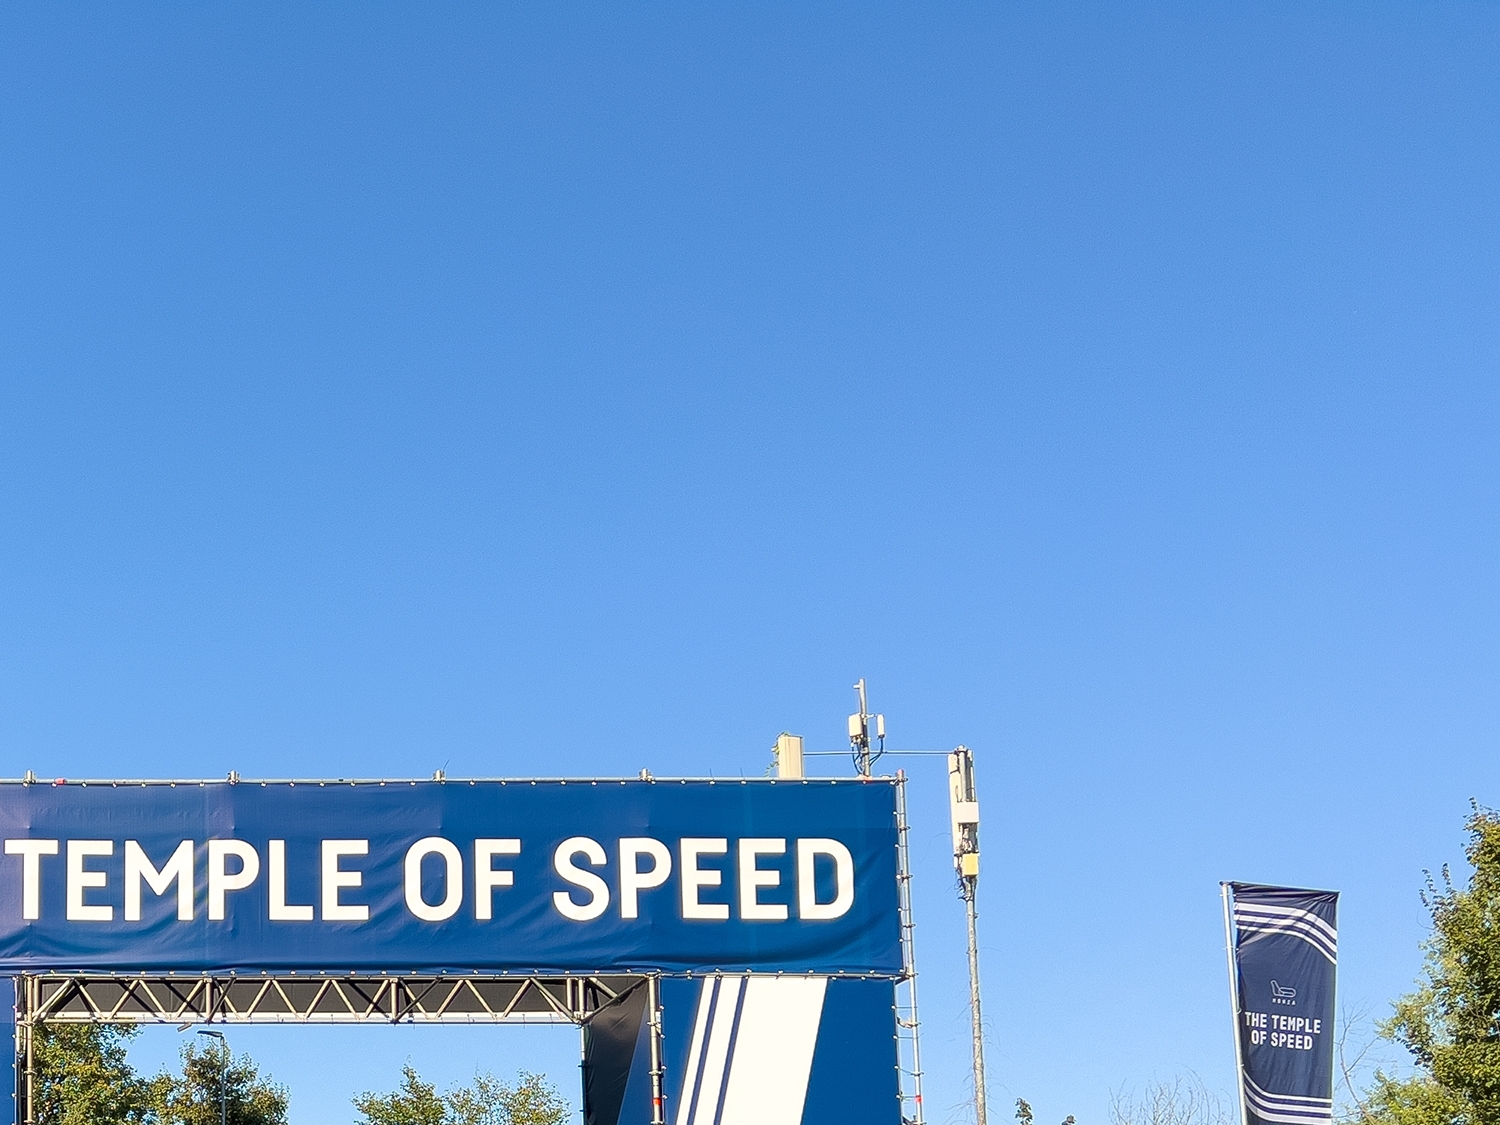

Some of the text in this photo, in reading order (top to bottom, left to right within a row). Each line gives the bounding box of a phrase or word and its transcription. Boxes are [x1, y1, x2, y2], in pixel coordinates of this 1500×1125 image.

[4, 839, 370, 922] TEMPLE
[403, 835, 521, 922] OF
[552, 835, 855, 922] SPEED
[1244, 1011, 1321, 1034] THE TEMPLE
[1251, 1029, 1313, 1050] OF SPEED
